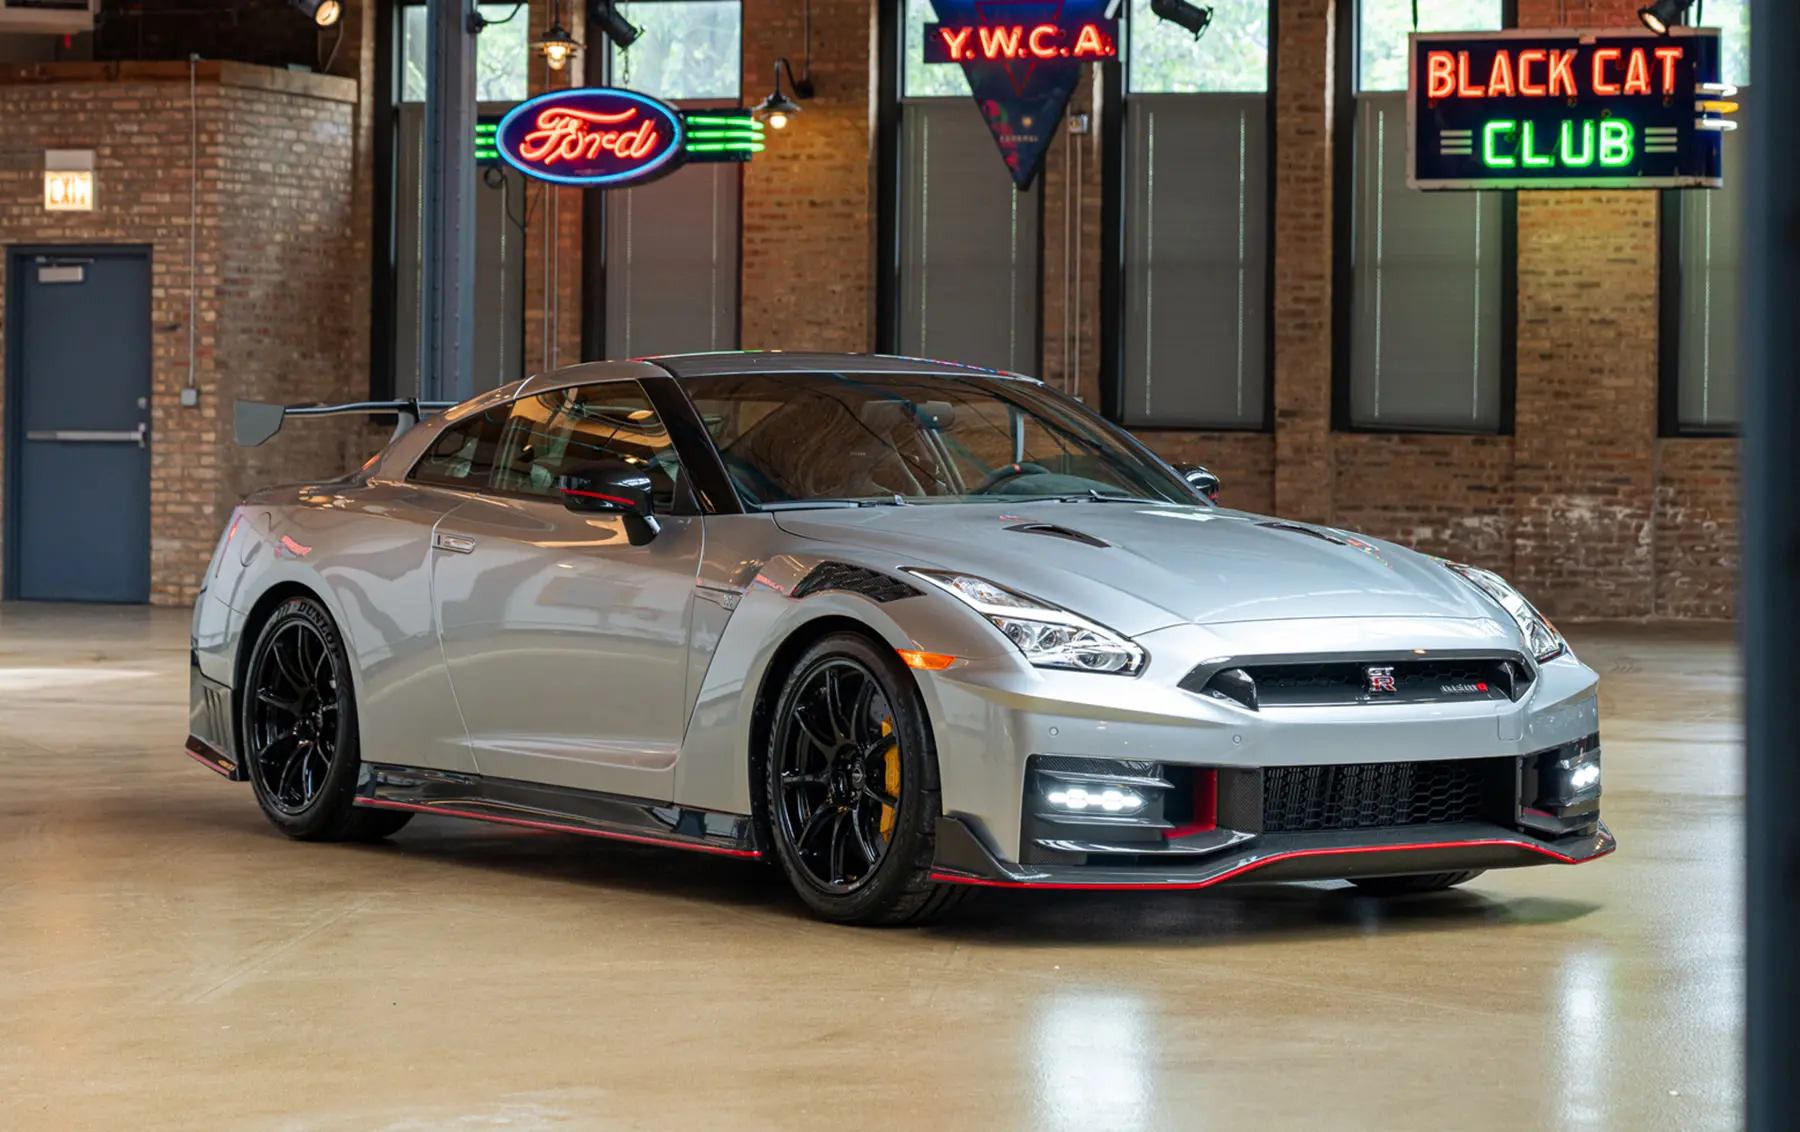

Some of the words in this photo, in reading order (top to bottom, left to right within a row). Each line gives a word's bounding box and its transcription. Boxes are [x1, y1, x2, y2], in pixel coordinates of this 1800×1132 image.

[939, 23, 1115, 59] Y.W.C.A.
[1427, 48, 1578, 98] BLACK
[1592, 47, 1683, 95] CAT
[519, 107, 659, 165] Ford
[1482, 119, 1635, 168] CLUB
[50, 177, 89, 205] EXIT
[297, 602, 341, 659] DUNLOP
